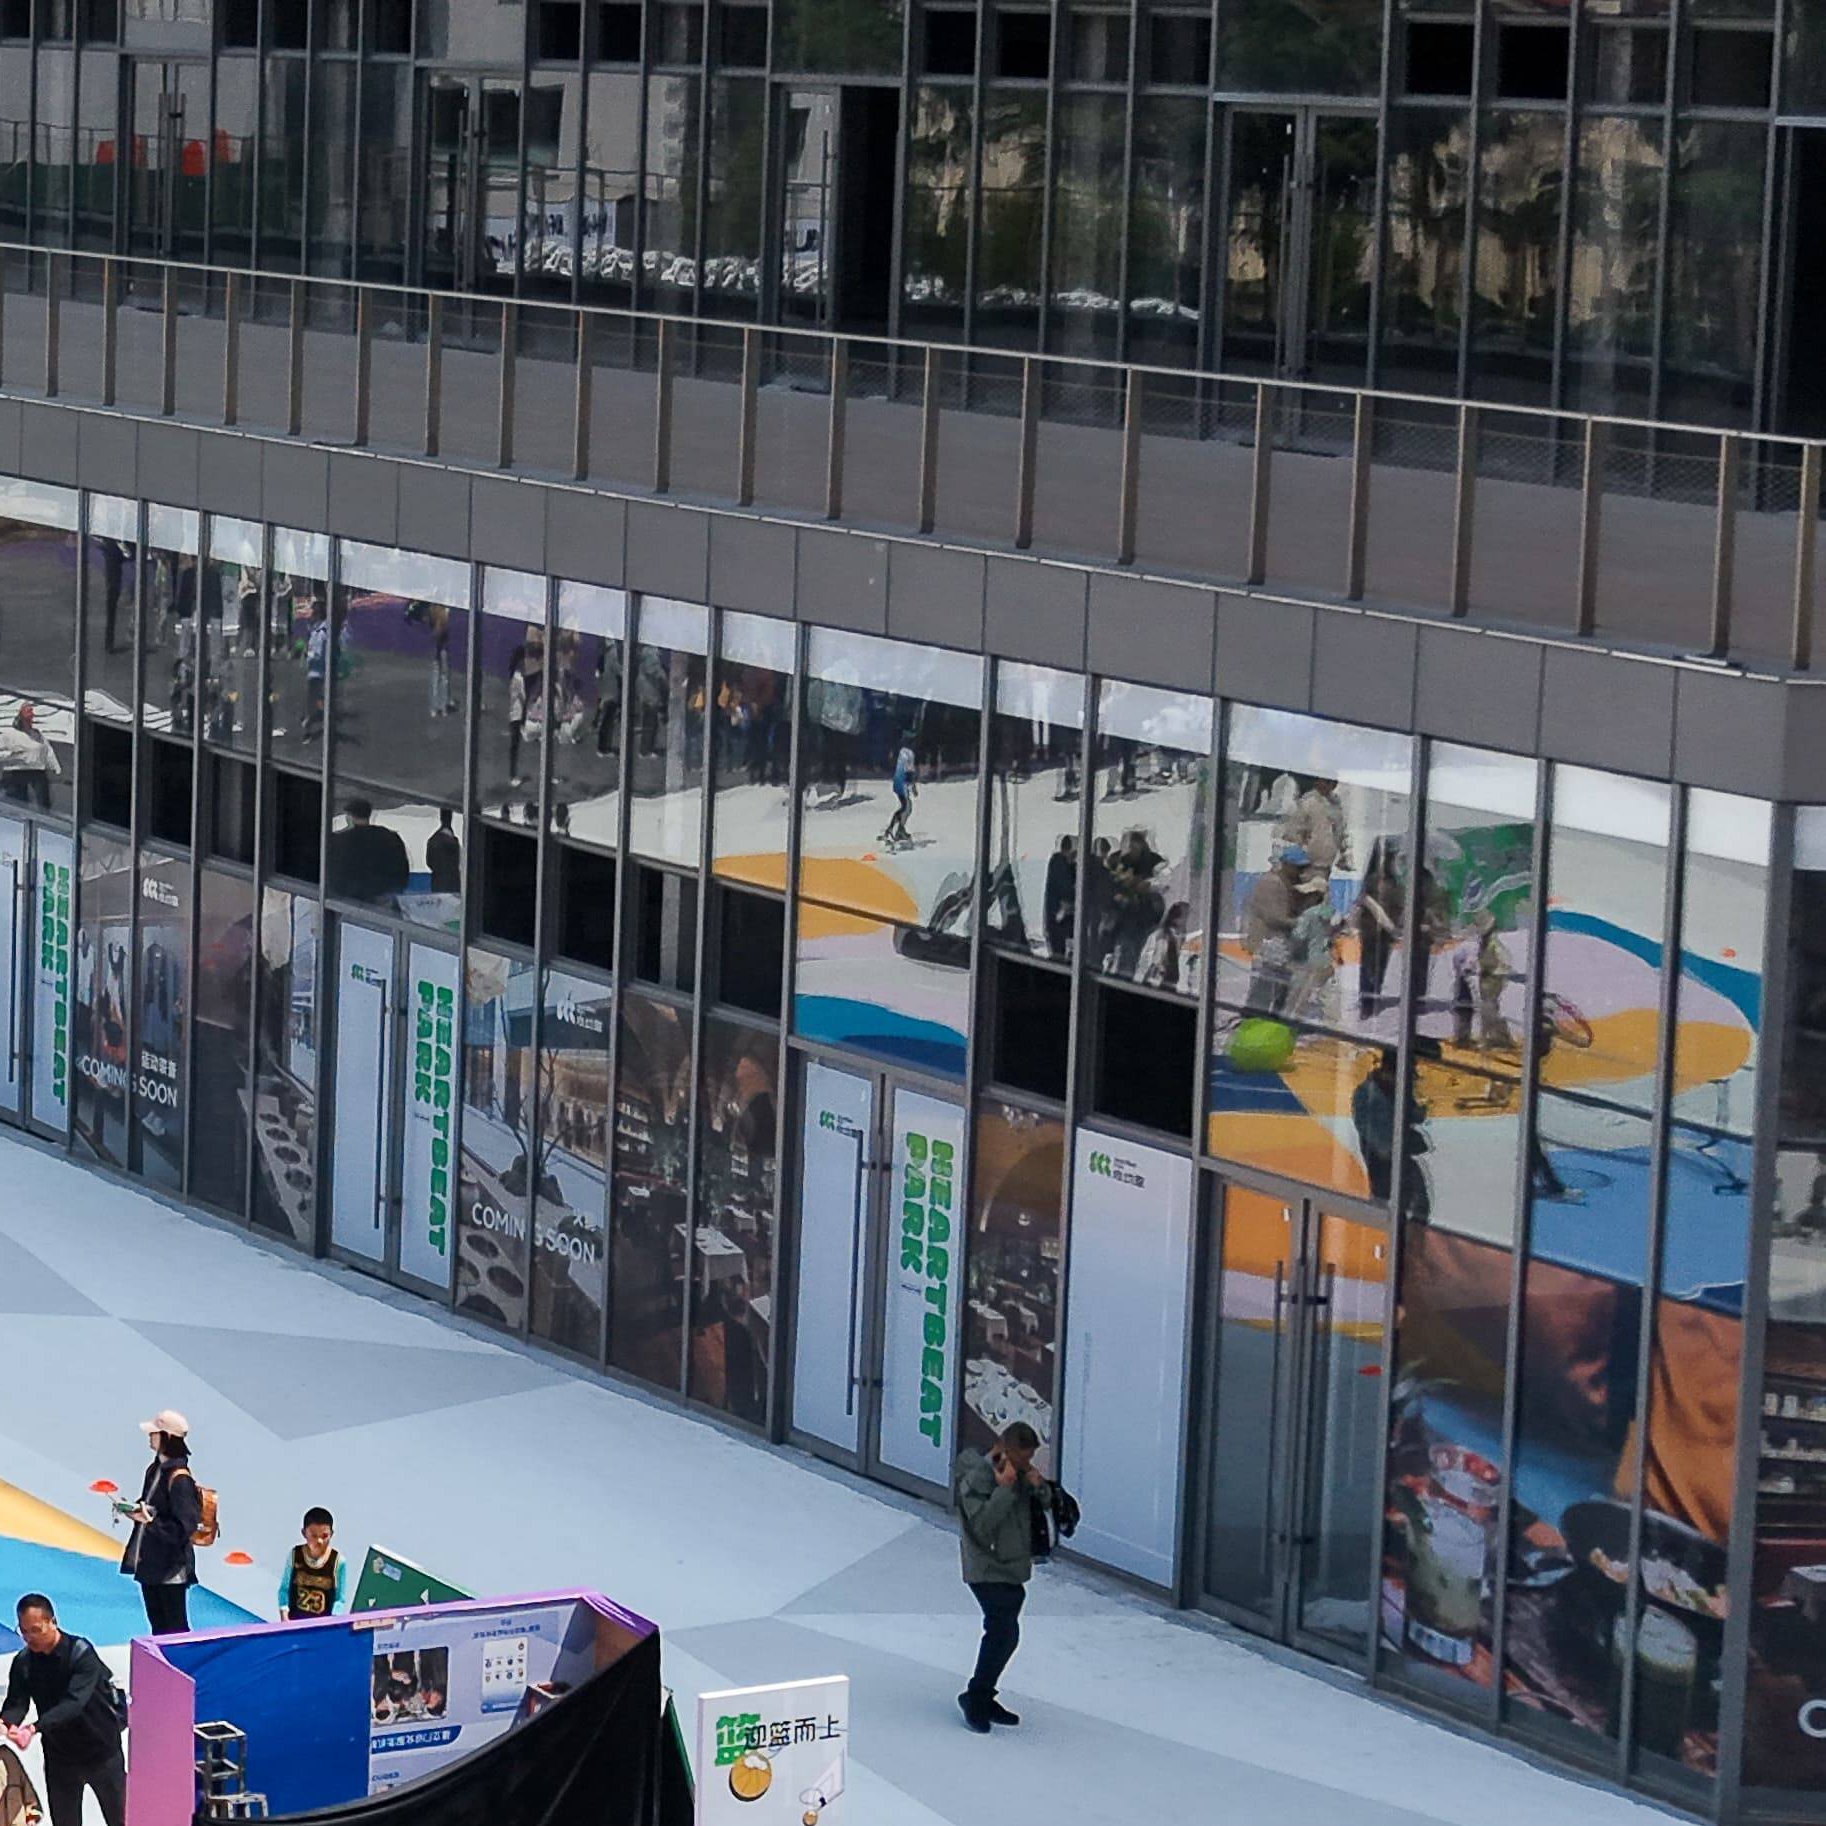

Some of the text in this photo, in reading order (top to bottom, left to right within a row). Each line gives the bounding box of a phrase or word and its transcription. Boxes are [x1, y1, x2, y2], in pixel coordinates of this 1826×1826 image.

[415, 980, 434, 1105] PARK
[139, 1078, 177, 1108] SOON
[900, 1131, 928, 1274] PARK
[545, 1228, 596, 1264] SOON
[297, 1589, 326, 1615] 23
[744, 1715, 841, 1750] 迎篮而上
